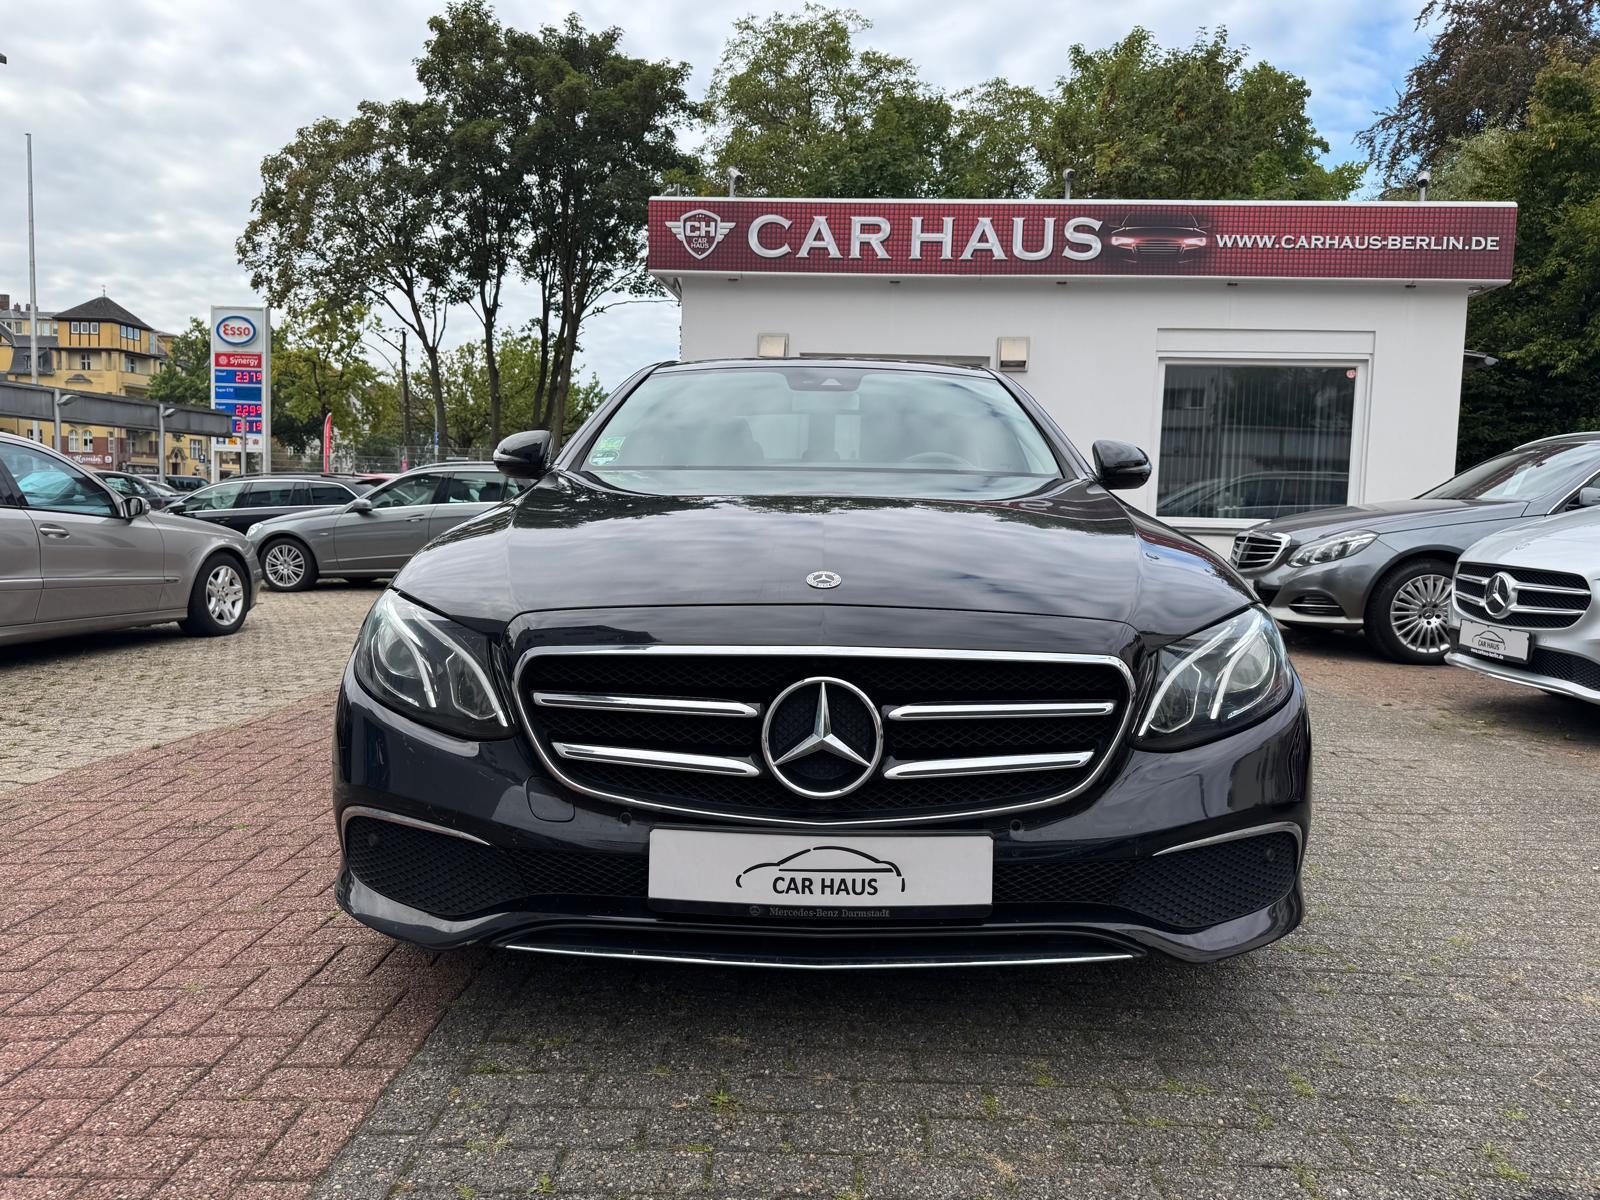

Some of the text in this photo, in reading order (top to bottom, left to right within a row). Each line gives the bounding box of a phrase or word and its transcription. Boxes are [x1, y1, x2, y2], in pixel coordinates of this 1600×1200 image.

[685, 221, 716, 237] CH
[1215, 234, 1500, 251] WWW.CARHAUS-BERLIN.DE
[222, 323, 251, 336] Esso
[229, 356, 259, 366] Synergy
[772, 876, 879, 896] CAR HAUS
[769, 906, 890, 918] Mercedes-Benz Darmstadt
